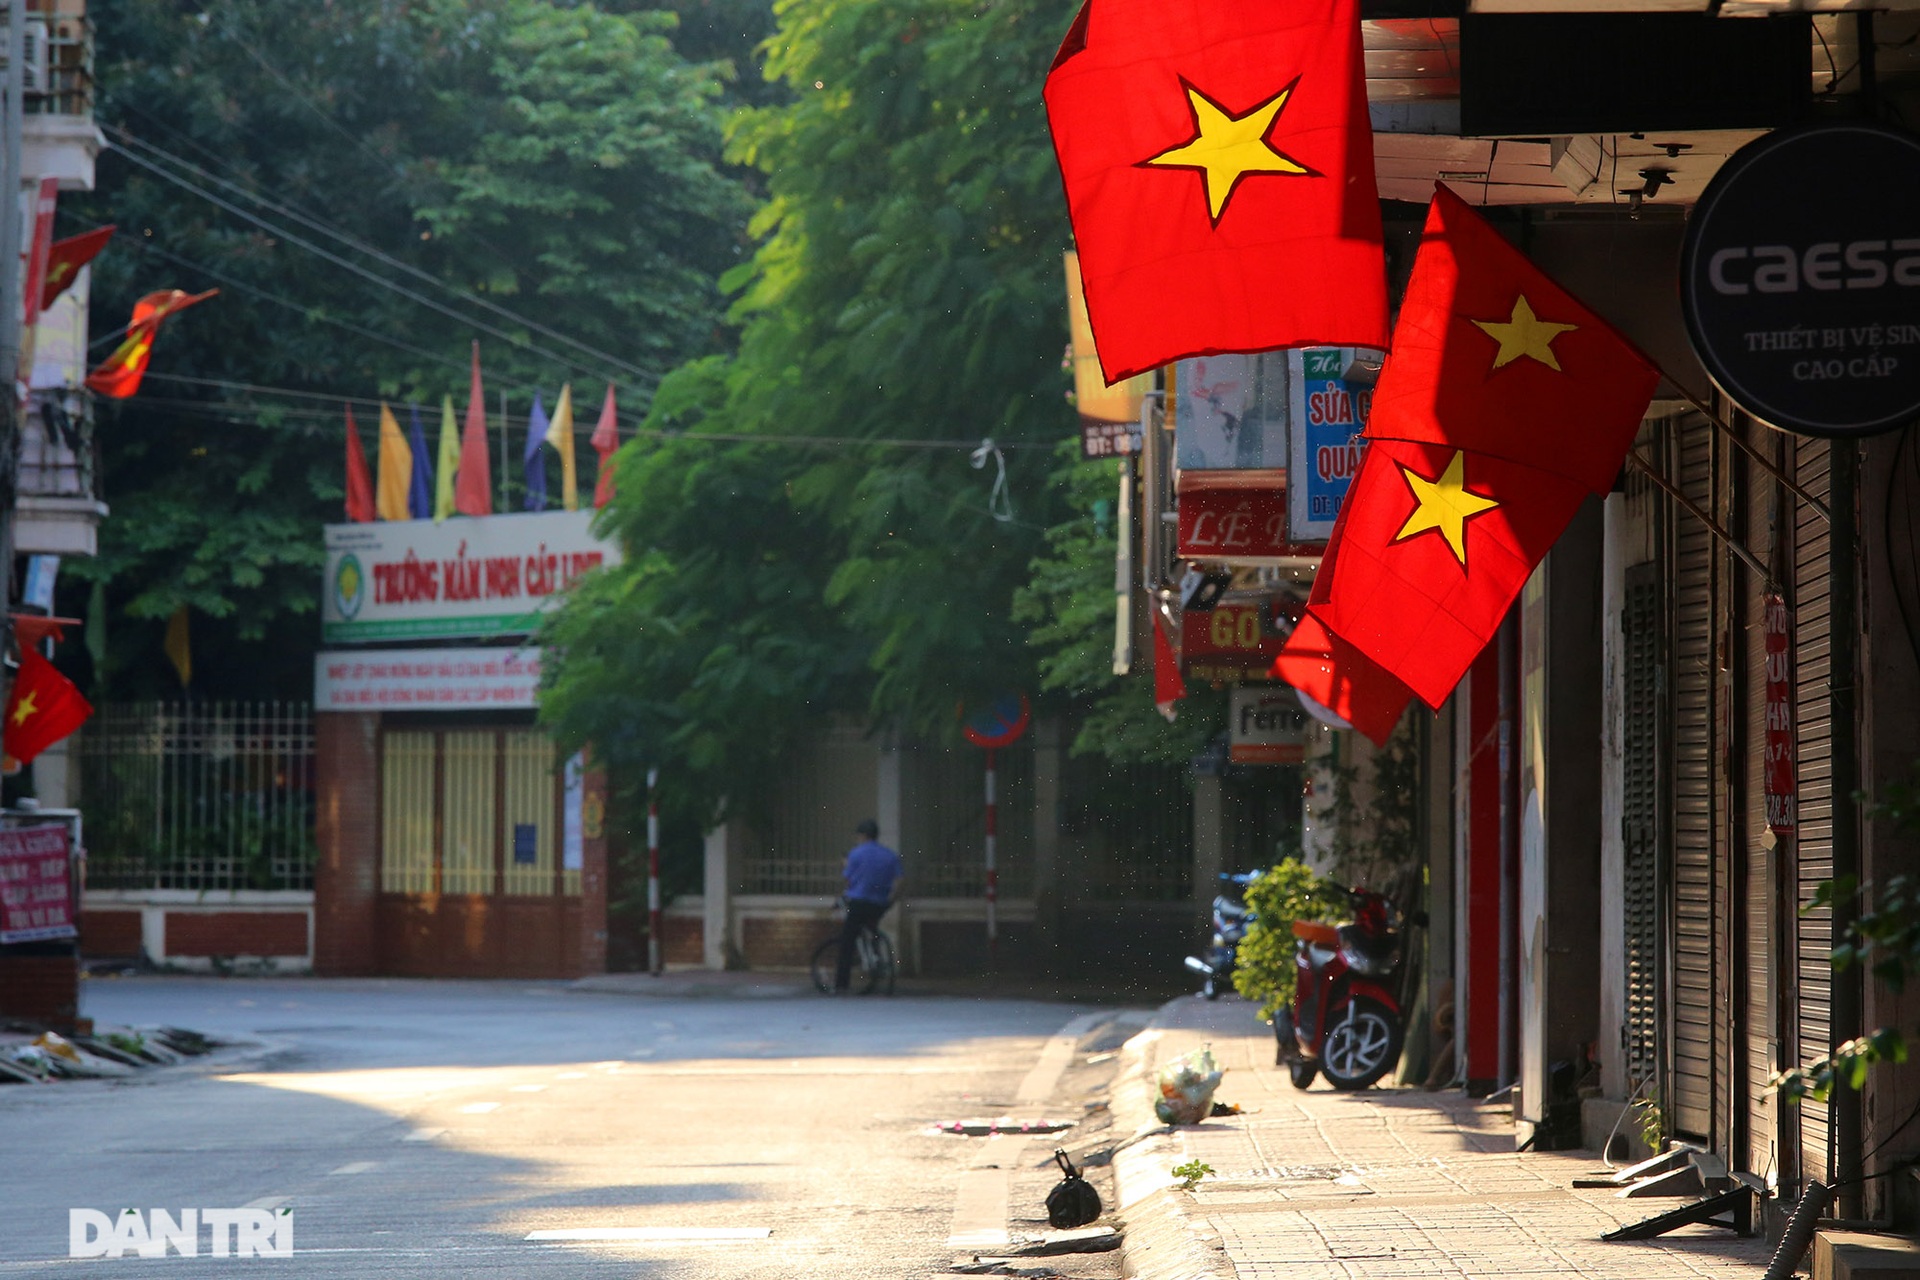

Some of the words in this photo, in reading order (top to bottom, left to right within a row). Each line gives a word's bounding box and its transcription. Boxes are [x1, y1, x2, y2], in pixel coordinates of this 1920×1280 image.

[1744, 324, 1818, 352] THIẾT
[1822, 328, 1844, 352] BỊ
[1849, 322, 1883, 350] VỆ
[1793, 359, 1844, 380] CAO
[1848, 350, 1898, 377] CẤP
[1309, 381, 1354, 426] SỬA
[1317, 437, 1367, 482] QUÂ
[1186, 501, 1252, 546] LÊ
